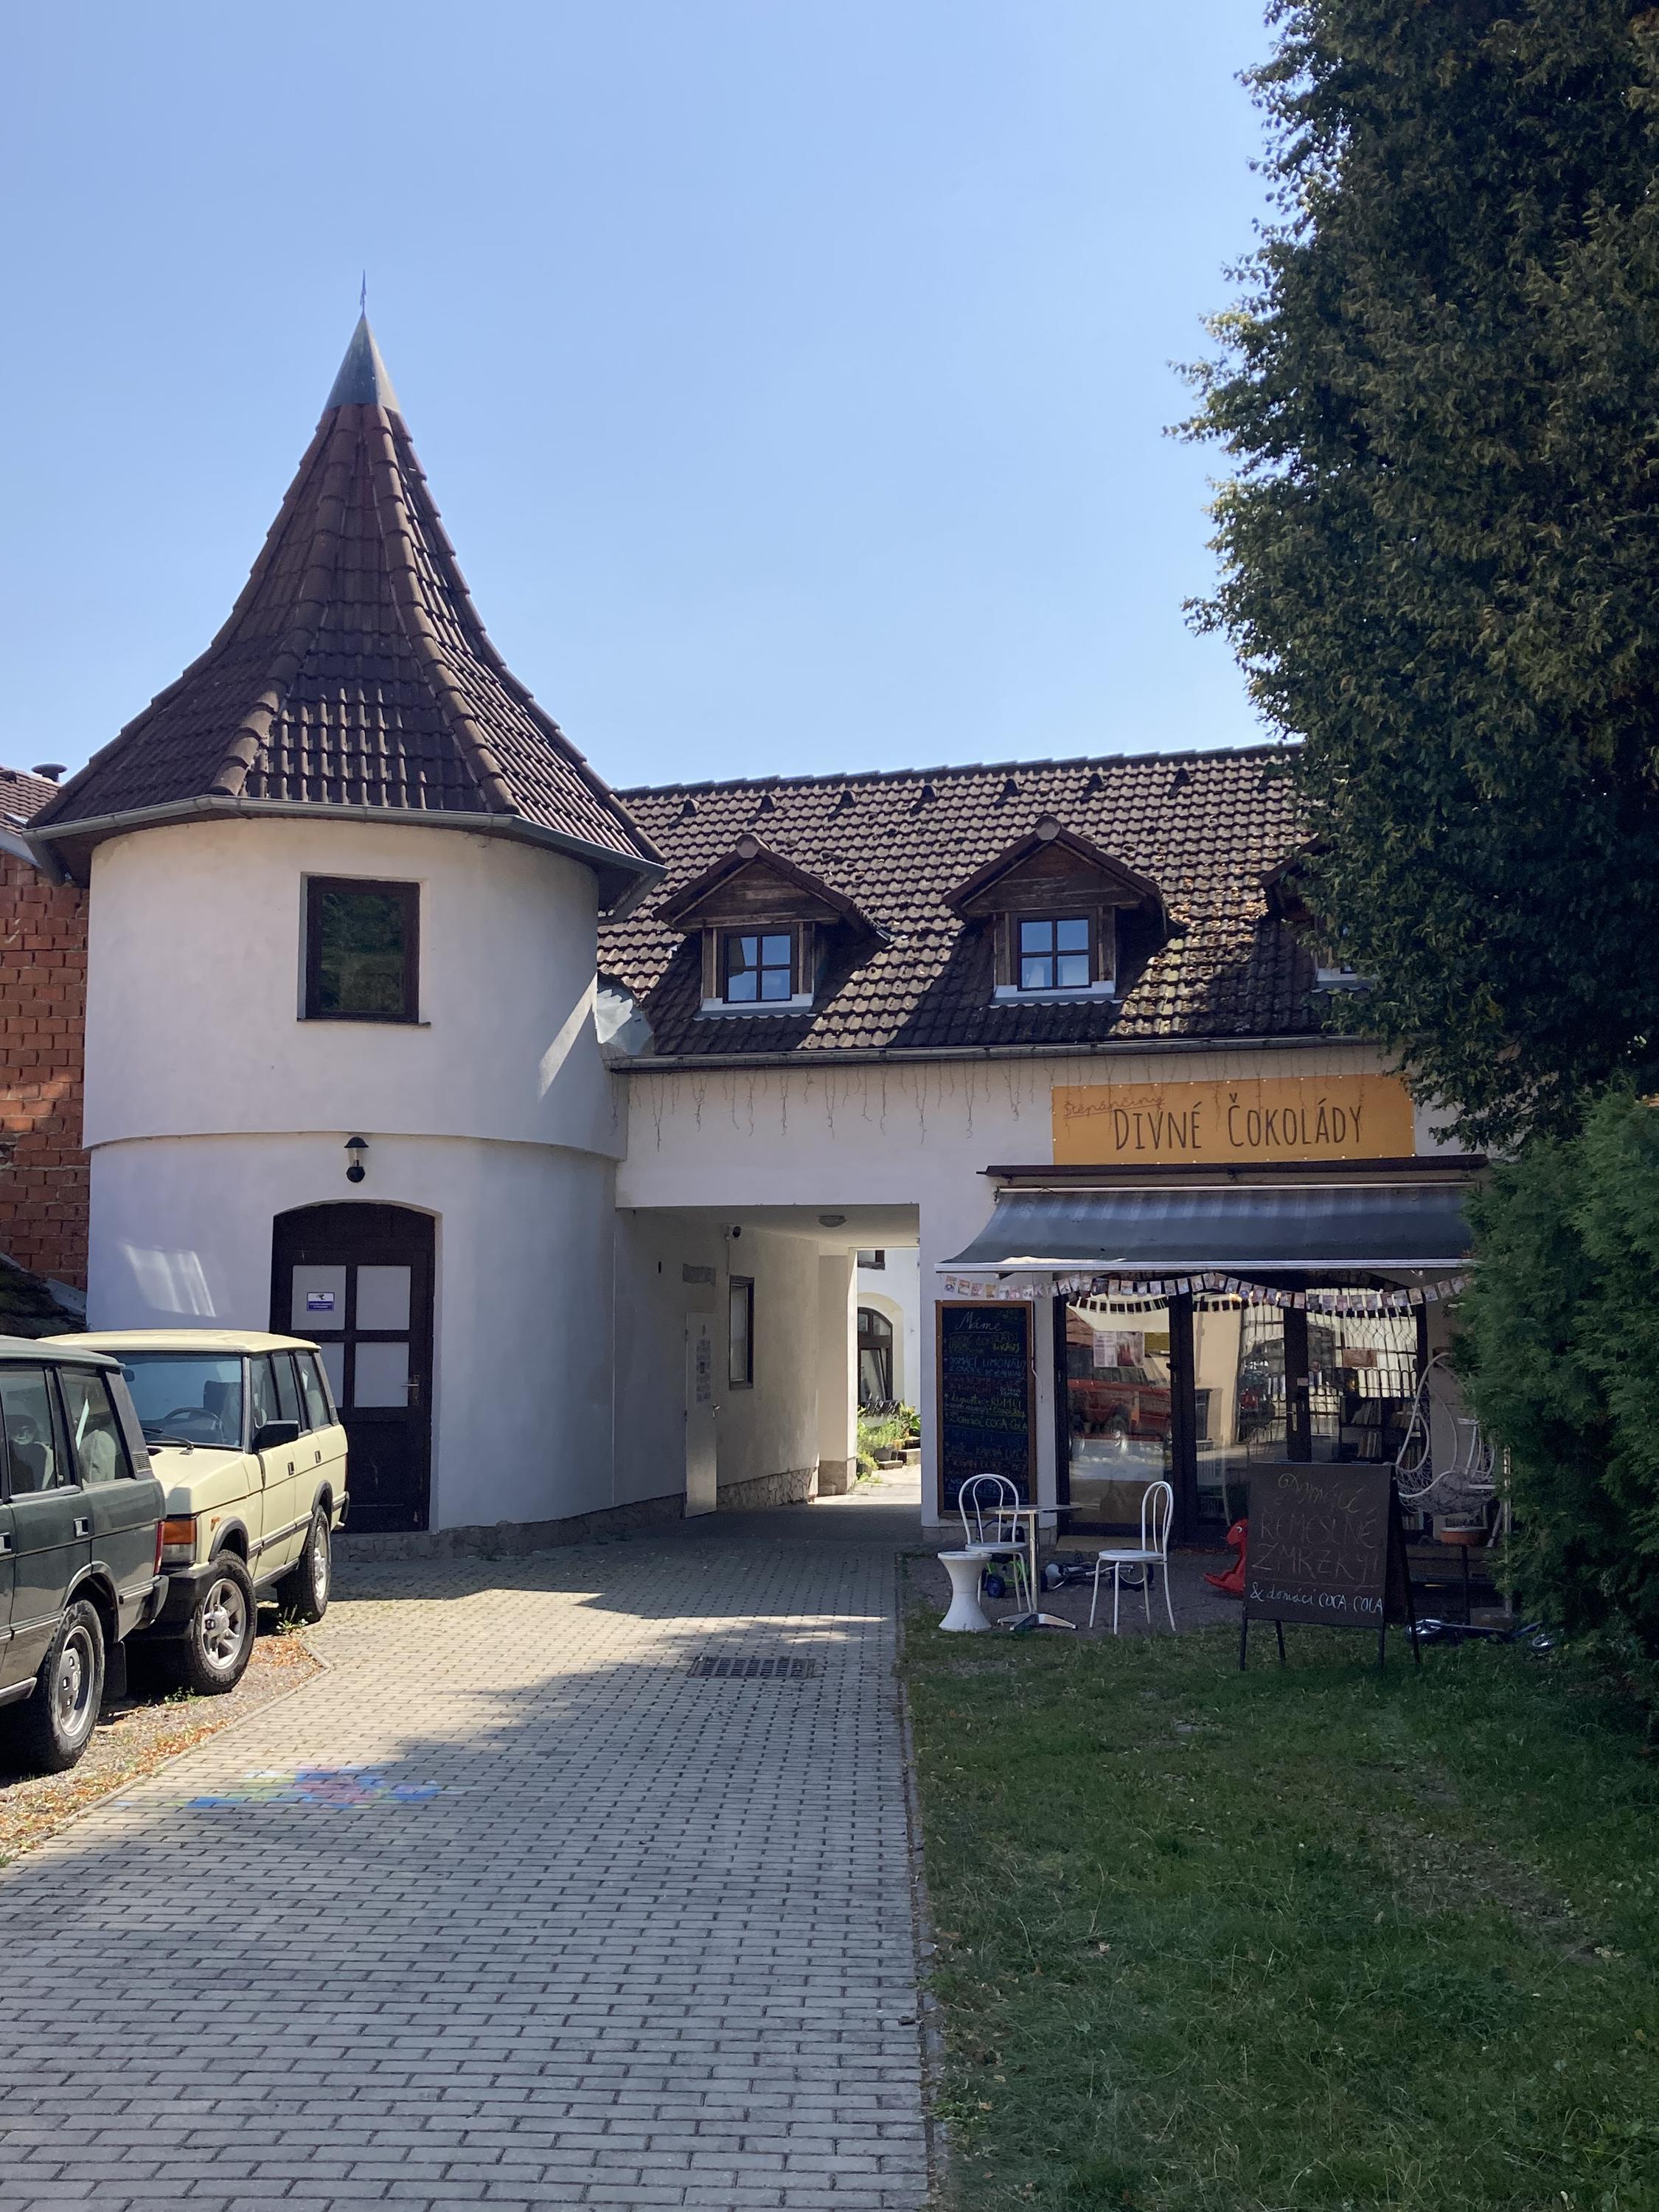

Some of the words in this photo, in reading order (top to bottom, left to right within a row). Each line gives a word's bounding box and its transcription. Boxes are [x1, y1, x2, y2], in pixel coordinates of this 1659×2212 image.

[1114, 1101, 1203, 1151] DIVNÉ
[1228, 1092, 1362, 1147] ČOKOLÁDY
[955, 1311, 1002, 1332] Máme
